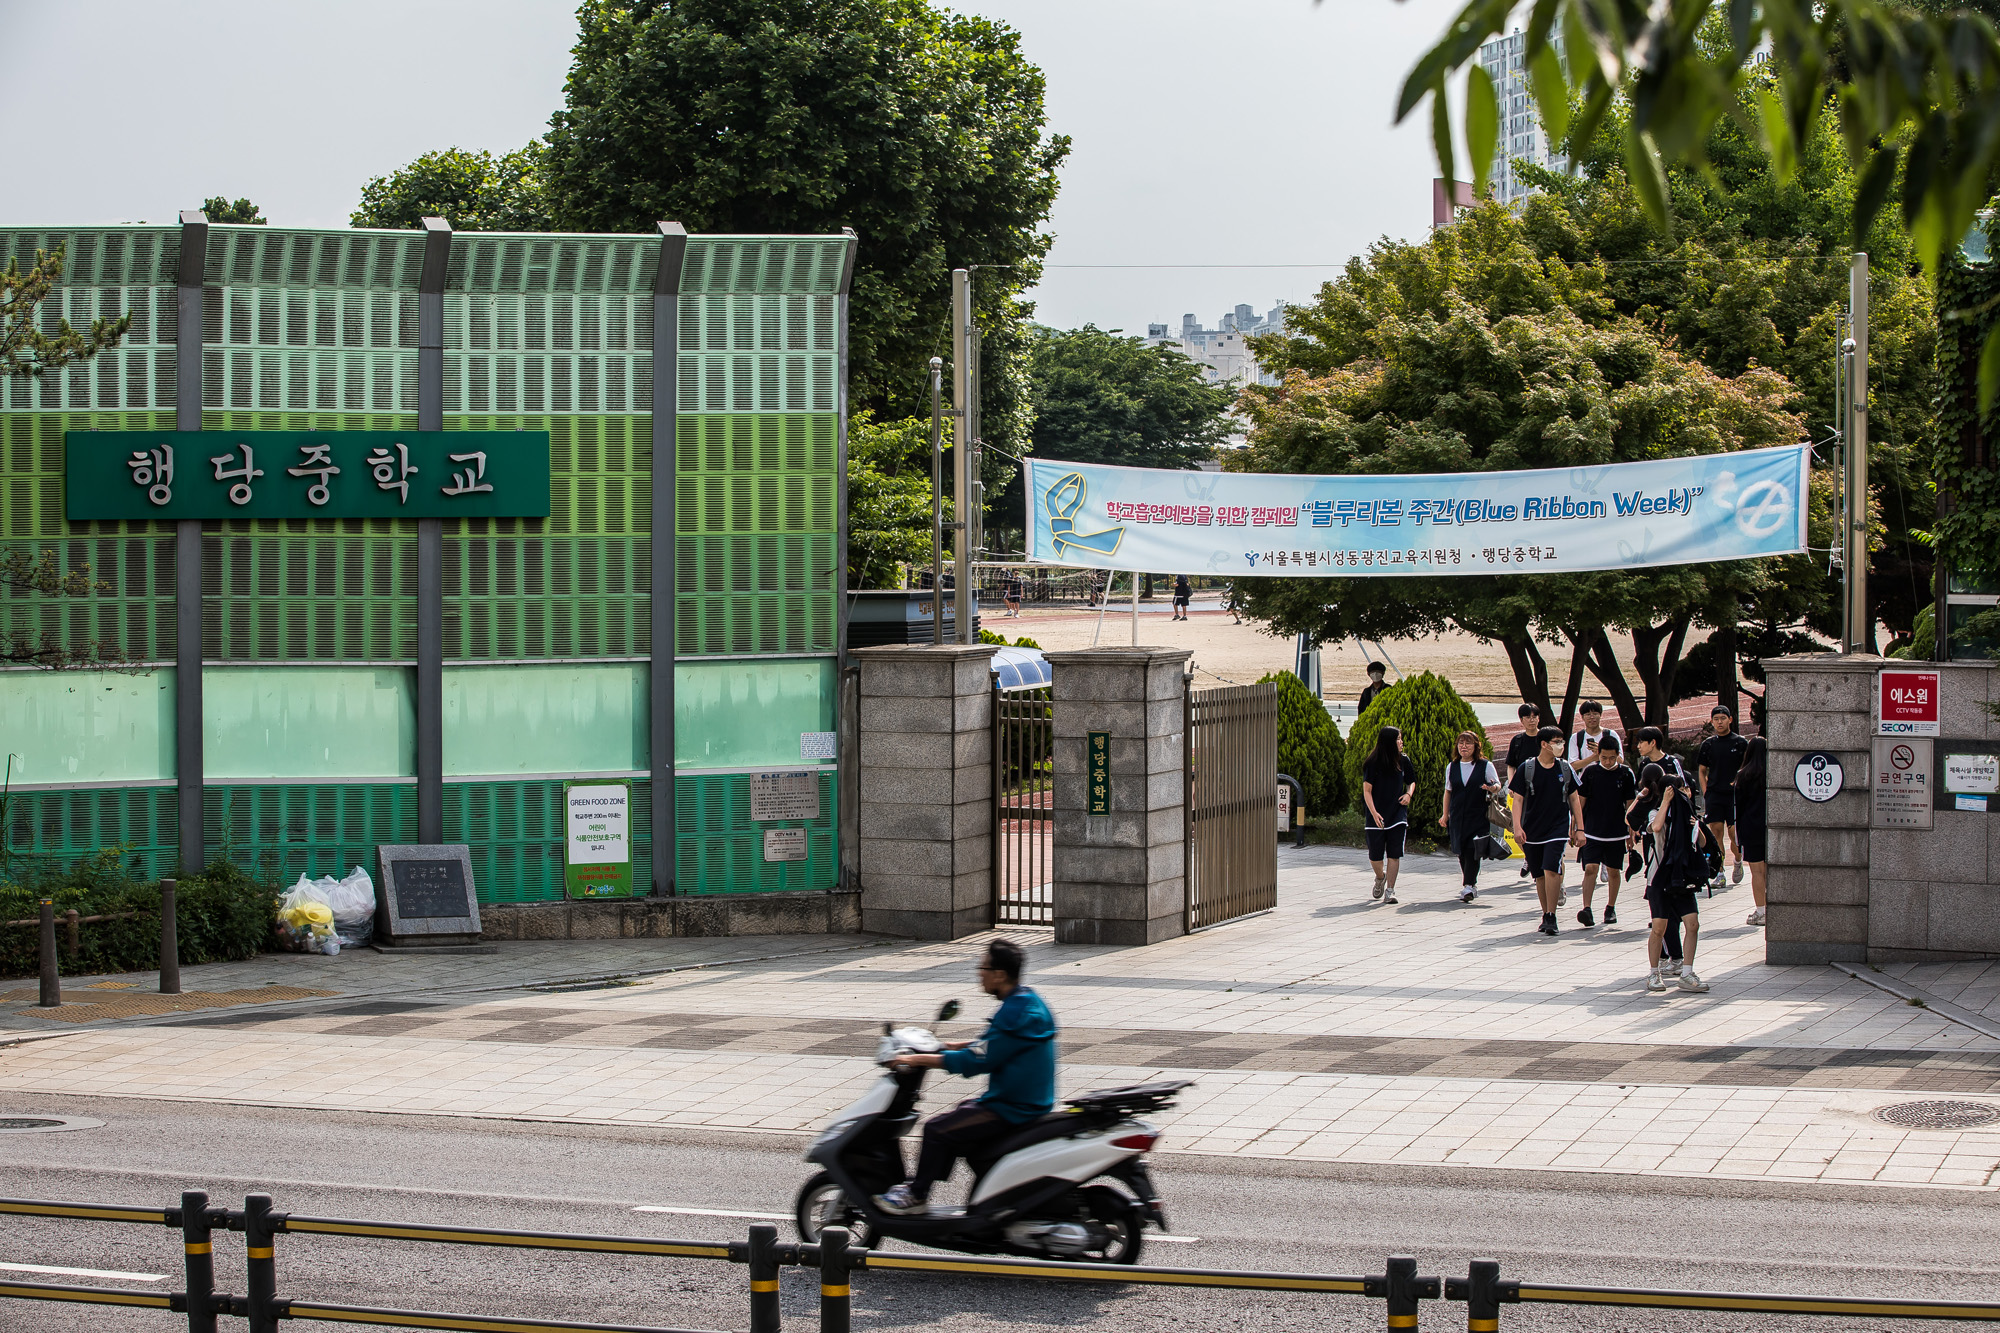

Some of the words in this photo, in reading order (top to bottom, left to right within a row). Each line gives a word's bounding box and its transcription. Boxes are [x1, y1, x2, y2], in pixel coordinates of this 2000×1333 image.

[127, 443, 494, 506] 행당중학교
[1105, 500, 1213, 526] 학교흡연예방을
[1215, 505, 1248, 526] 위한
[1250, 505, 1298, 527] 캠페인
[1300, 499, 1404, 527] “블루리본
[1407, 497, 1519, 526] 주간(Blue
[1522, 495, 1607, 521] Ribbon
[1612, 486, 1704, 517] Week)”
[1262, 549, 1462, 567] 서울특별시성동광진교육지원청
[1482, 546, 1558, 565] 행당중학교
[1890, 688, 1928, 704] 에스원
[1881, 723, 1914, 733] SECOM
[1092, 736, 1107, 812] 행당중학교
[1806, 772, 1832, 786] 189
[1880, 772, 1925, 785] 금연구역
[576, 834, 622, 842] 식품안전보호구역
